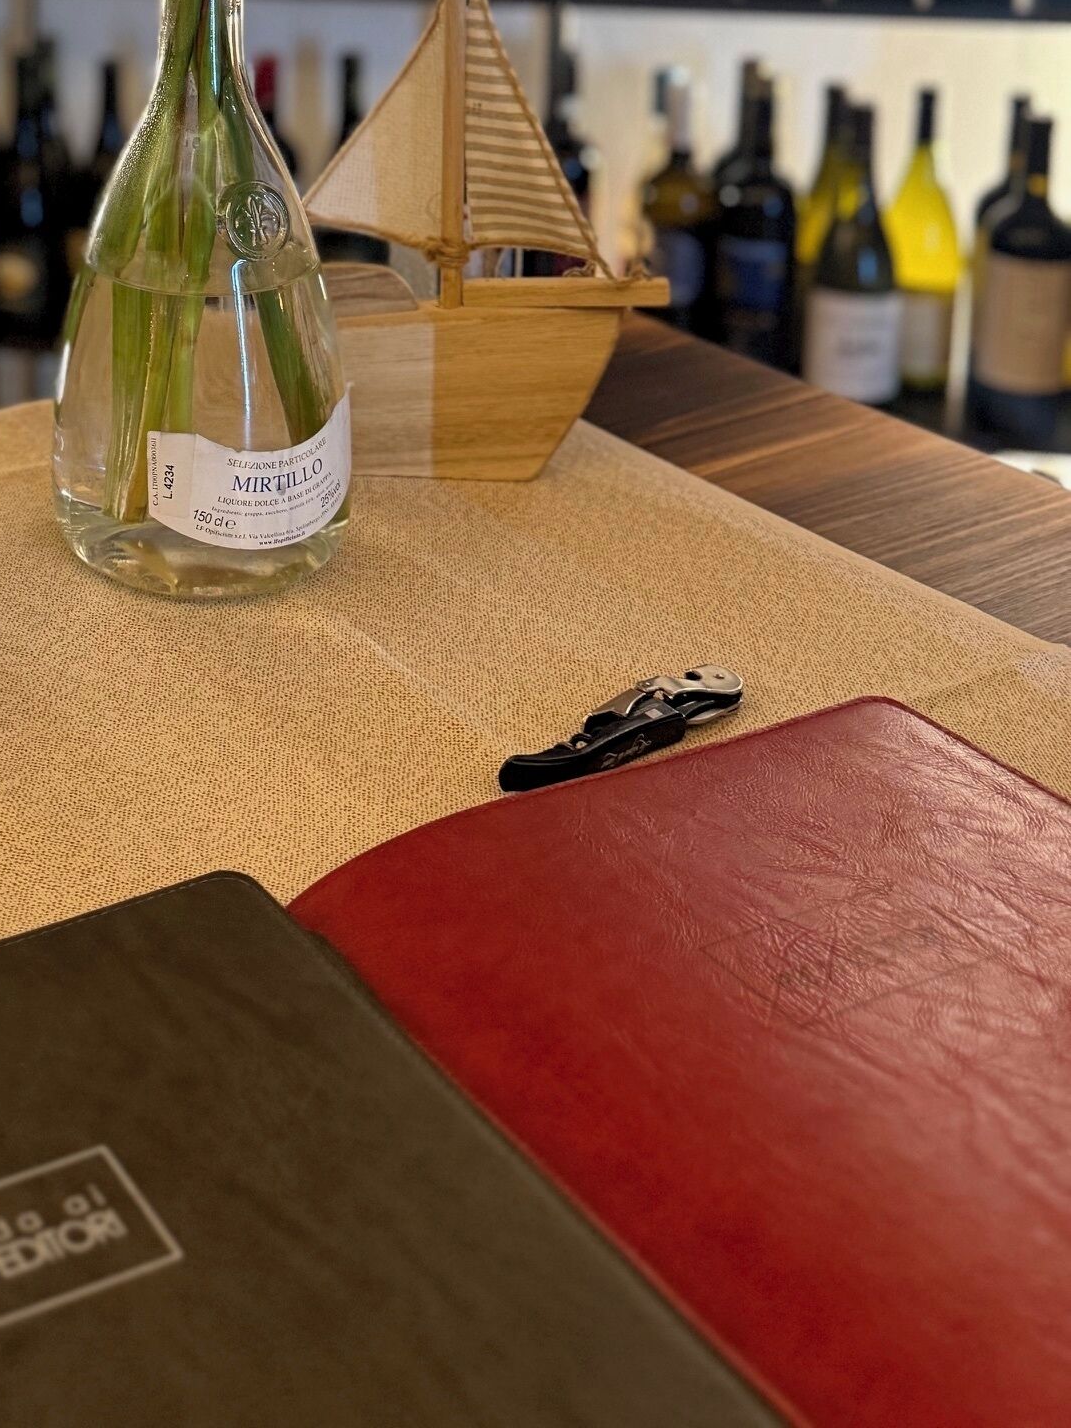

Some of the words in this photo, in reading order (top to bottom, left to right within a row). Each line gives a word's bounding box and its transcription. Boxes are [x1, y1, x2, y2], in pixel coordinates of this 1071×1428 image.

[227, 458, 277, 469] SELEZIONE
[279, 437, 326, 468] PARTICOLARE
[163, 464, 175, 500] L.4234
[217, 496, 253, 507] LIQUORE
[254, 498, 280, 507] DOLCE
[287, 491, 305, 502] BASE
[305, 487, 312, 495] DI
[312, 472, 335, 491] GRAPPA
[231, 458, 323, 493] MIRTILLO
[193, 509, 213, 524] 150
[214, 516, 224, 527] cl
